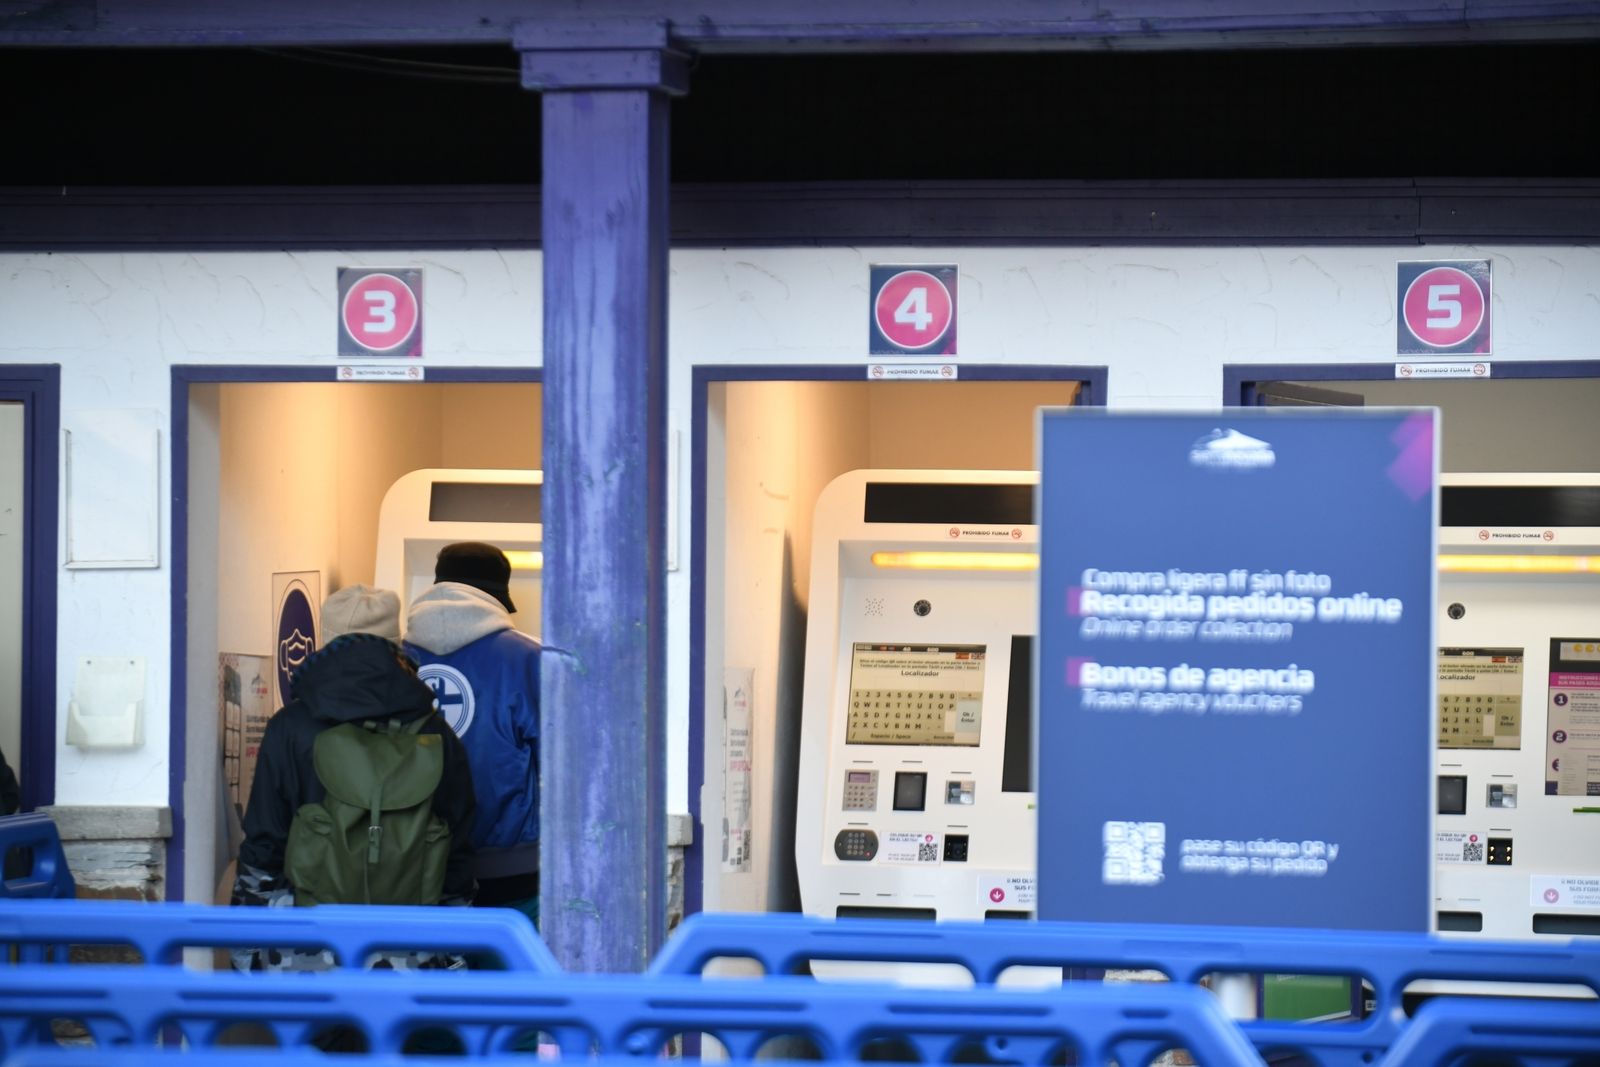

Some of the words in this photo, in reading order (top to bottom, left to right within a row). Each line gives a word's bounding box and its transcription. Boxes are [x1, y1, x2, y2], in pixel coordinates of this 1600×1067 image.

[363, 290, 396, 333] 3
[894, 287, 933, 331] 4
[1426, 284, 1462, 329] 5
[1081, 568, 1165, 593] Compra
[1250, 569, 1284, 594] sin
[1285, 569, 1331, 595] foto
[1080, 589, 1205, 619] Recogida
[1206, 590, 1315, 621] pedidos
[1317, 592, 1403, 623] online
[1080, 616, 1144, 640] Online
[1145, 617, 1200, 641] order
[1199, 617, 1294, 642] collection
[1080, 662, 1167, 691] Bonos
[1168, 663, 1205, 692] de
[1207, 663, 1315, 695] agencia
[1081, 688, 1139, 710] Travel
[1140, 690, 1210, 715] agency
[1211, 691, 1302, 713] vouchers
[1558, 695, 1564, 704] 1
[1556, 732, 1563, 741] 2
[1301, 840, 1326, 858] QR
[1272, 857, 1327, 877] pedido
